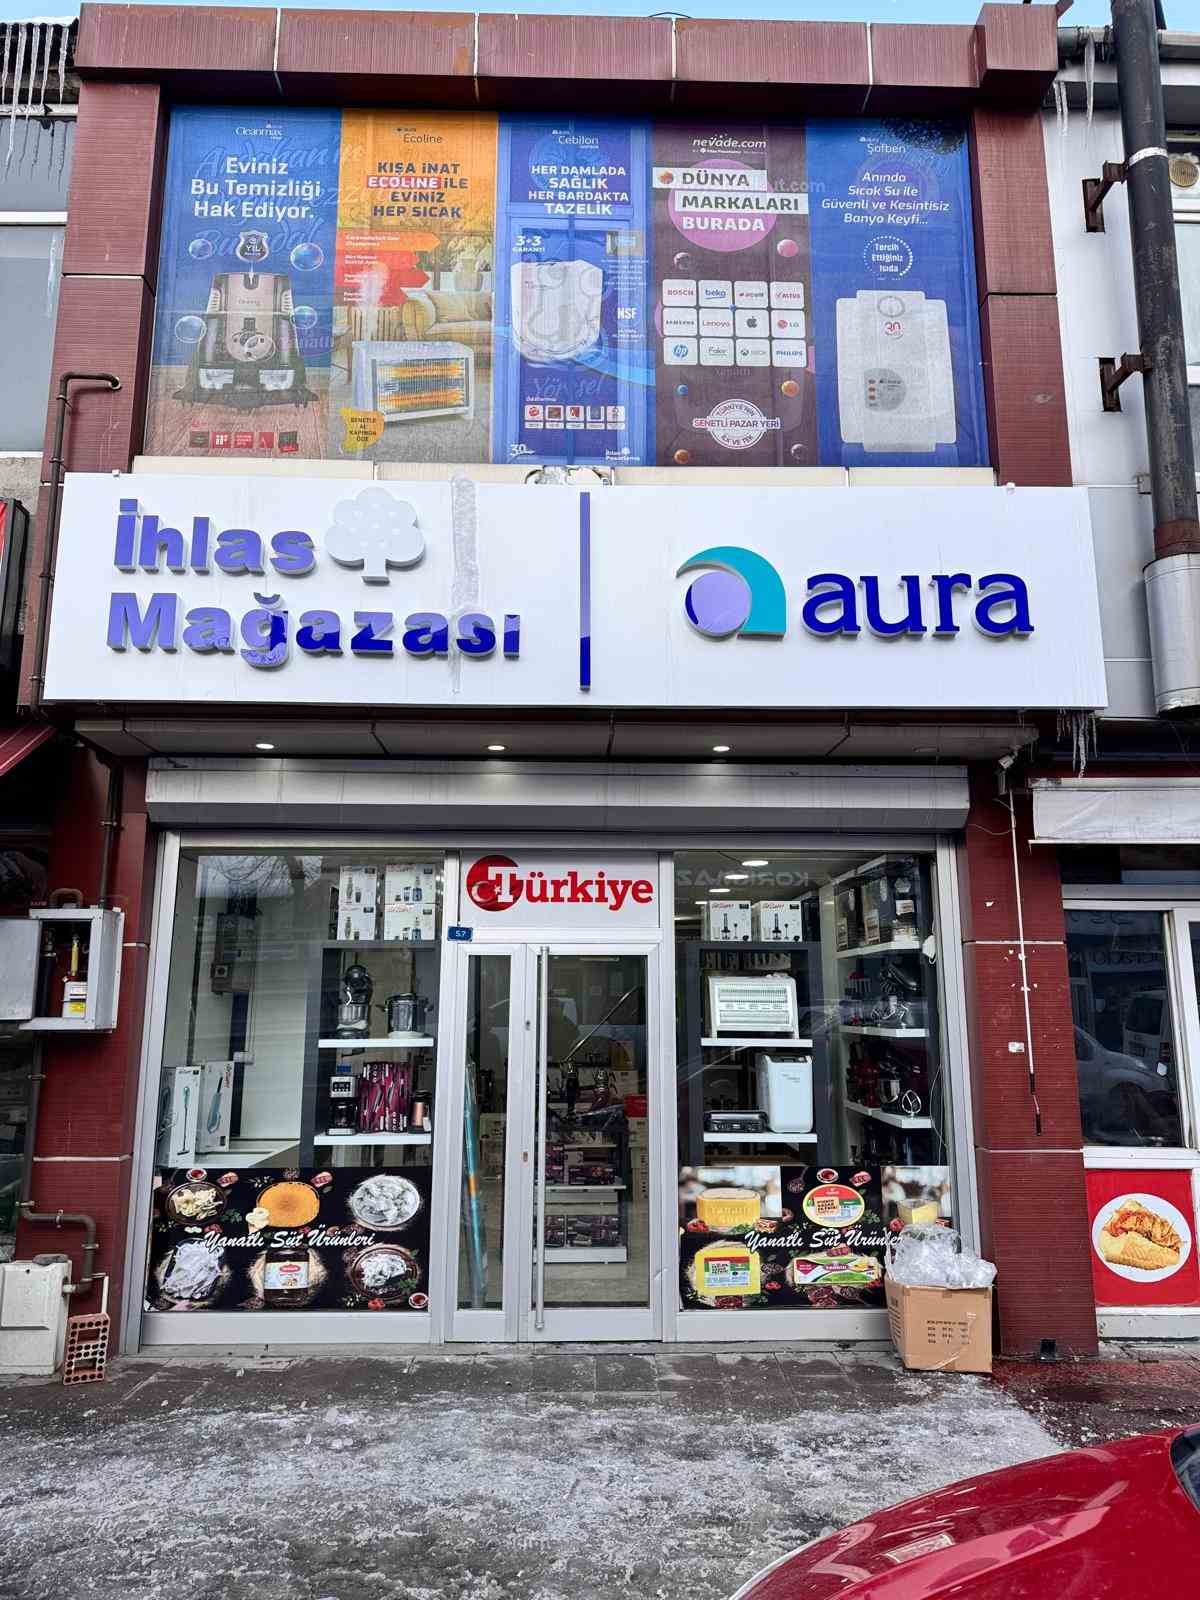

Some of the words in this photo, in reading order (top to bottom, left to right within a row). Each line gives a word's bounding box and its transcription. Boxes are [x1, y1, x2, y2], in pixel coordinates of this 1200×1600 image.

[235, 126, 283, 136] Cleanmax
[403, 133, 443, 144] Ecoline
[558, 135, 599, 145] Cebilon
[692, 136, 767, 149] nevade.com
[867, 143, 906, 155] Şofben
[226, 156, 289, 175] Eviniz
[377, 162, 416, 174] KIŞA
[531, 165, 558, 175] HER
[561, 165, 626, 176] DAMLADA
[549, 174, 608, 189] SAĞLIK
[681, 169, 750, 187] DÜNYA
[862, 172, 907, 182] Anında
[191, 178, 219, 195] Bu
[225, 178, 321, 200] Temizliği
[848, 186, 881, 196] Sıcak
[884, 186, 900, 196] Su
[528, 190, 555, 200] HER
[558, 191, 629, 202] BARDAKTA
[544, 201, 612, 215] TAZELİK
[681, 195, 799, 211] MARKALARI
[821, 198, 869, 209] Güvenli
[872, 201, 887, 209] ve
[890, 199, 950, 212] Kesintisiz
[194, 200, 236, 217] Hak
[241, 201, 314, 222] Ediyor.
[373, 205, 407, 217] HEP
[412, 206, 461, 218] SICAK
[682, 216, 766, 231] BURADA
[843, 213, 885, 226] Banyo
[874, 243, 900, 251] Tercih
[667, 288, 694, 296] BOSCH
[704, 288, 727, 298] beko
[617, 307, 637, 320] NSF
[729, 419, 759, 428] PAZAR
[113, 498, 318, 576] İhlas
[802, 572, 1036, 638] aura
[106, 591, 521, 669] Mağazası
[487, 865, 654, 912] Türkiye
[202, 1231, 265, 1254] Yanatlı
[270, 1230, 303, 1249] Süt
[307, 1224, 376, 1247] Ürünleri
[744, 1230, 803, 1254] Yanatlı
[809, 1228, 842, 1249] Süt
